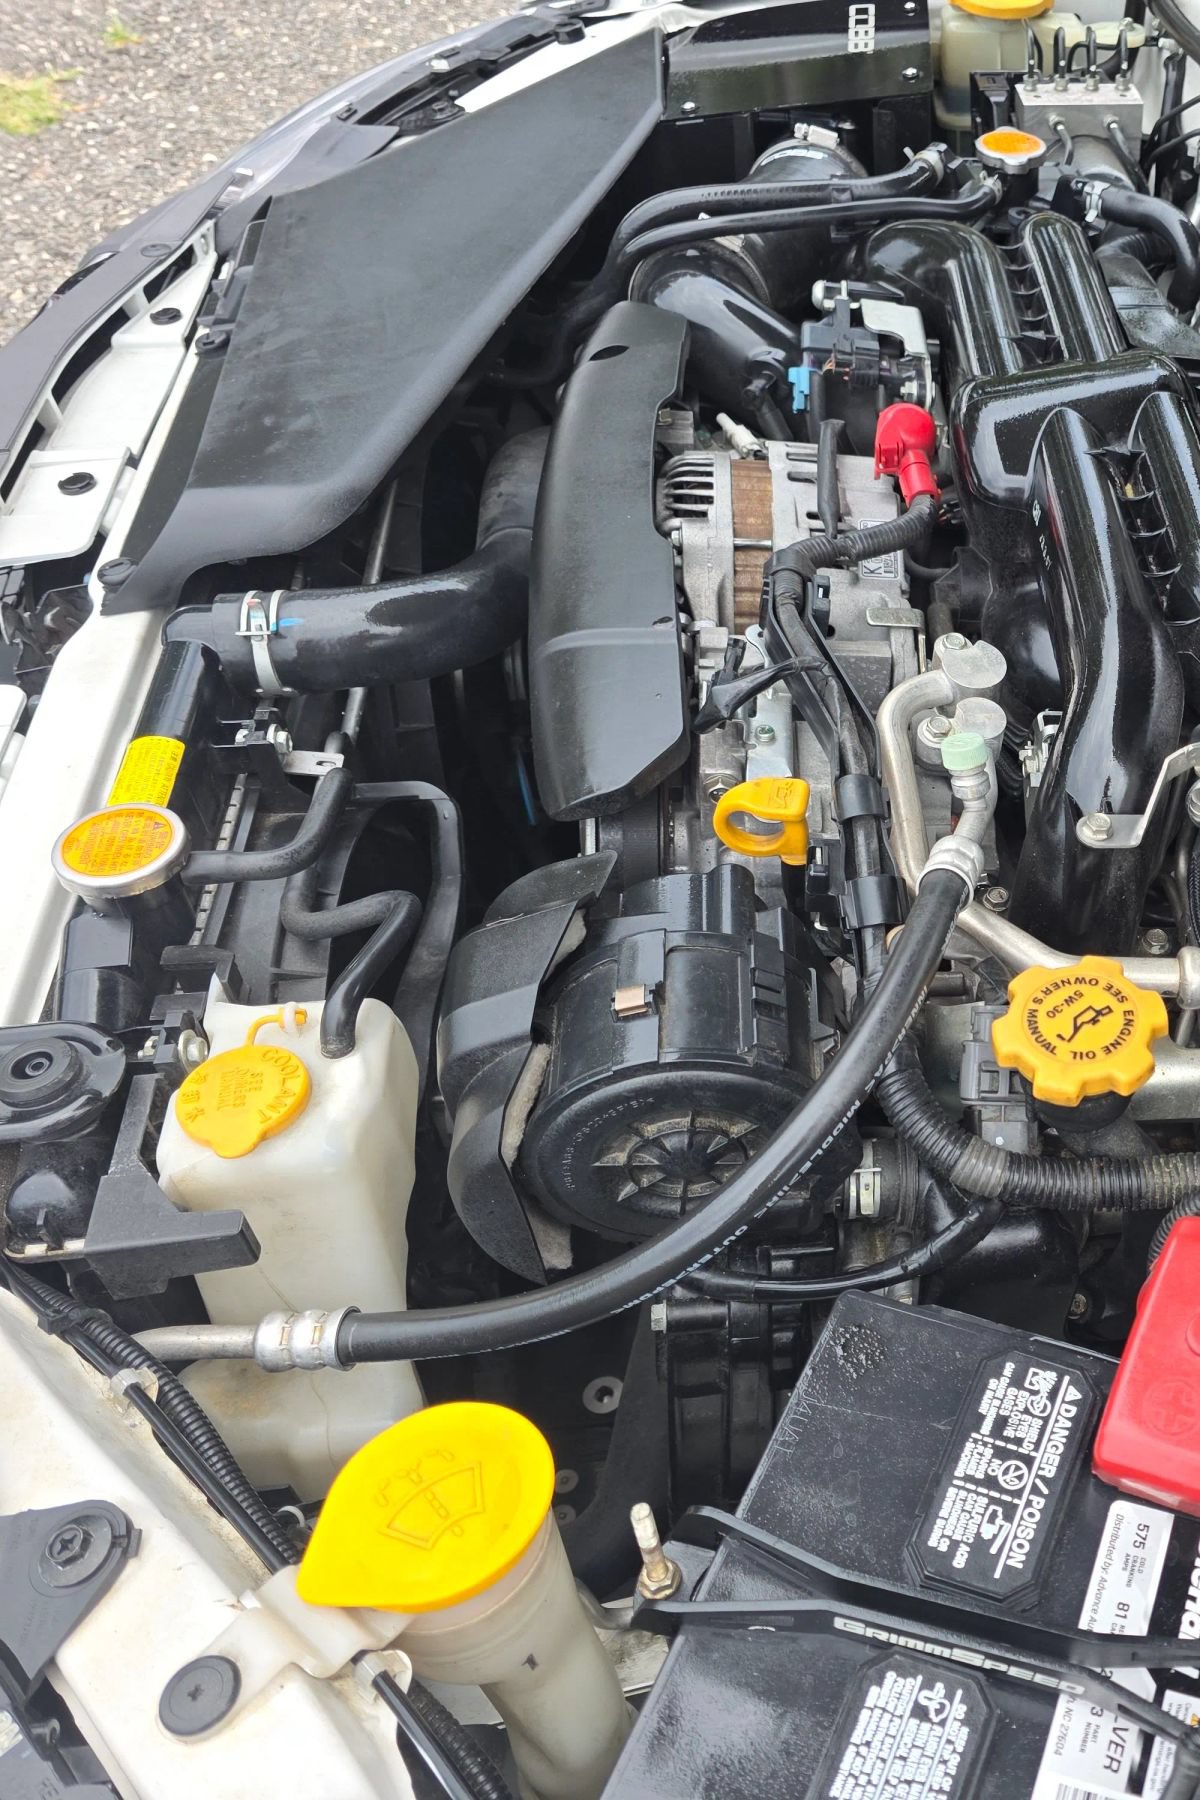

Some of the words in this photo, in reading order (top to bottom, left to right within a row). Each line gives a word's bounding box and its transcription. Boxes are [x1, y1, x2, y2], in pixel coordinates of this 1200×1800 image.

[1032, 976, 1099, 1005] OWNER'S
[1046, 989, 1084, 1018] 5W-30
[1102, 982, 1128, 1003] SEE
[1026, 1008, 1056, 1055] MANUAL
[1101, 1009, 1134, 1055] ENGINE
[1069, 1050, 1096, 1060] OIL
[261, 1049, 300, 1124] COOLANT
[999, 1387, 1018, 1416] GASES
[1003, 1390, 1030, 1438] EXPLOSIVE
[1014, 1414, 1032, 1438] EYES
[1022, 1417, 1043, 1450] SHIELD
[1037, 1403, 1077, 1478] DANGER
[987, 1458, 1002, 1476] NO
[960, 1495, 988, 1543] SULFURIC
[1006, 1494, 1046, 1569] POISON
[1105, 1513, 1125, 1562] Distributed
[1132, 1523, 1150, 1550] 575
[952, 1543, 970, 1568] ACID
[1100, 1561, 1112, 1574] by:
[1137, 1557, 1146, 1574] COLD
[1091, 1576, 1108, 1615] Advance
[1115, 1602, 1130, 1619] 81
[1063, 1707, 1074, 1722] NC
[944, 1718, 961, 1742] NOT
[951, 1724, 970, 1752] KEEP
[1054, 1723, 1070, 1756] 27604
[1079, 1722, 1092, 1753] NUMBER
[1091, 1724, 1101, 1743] PART
[943, 1751, 960, 1775] OUT
[938, 1777, 952, 1792] OF
